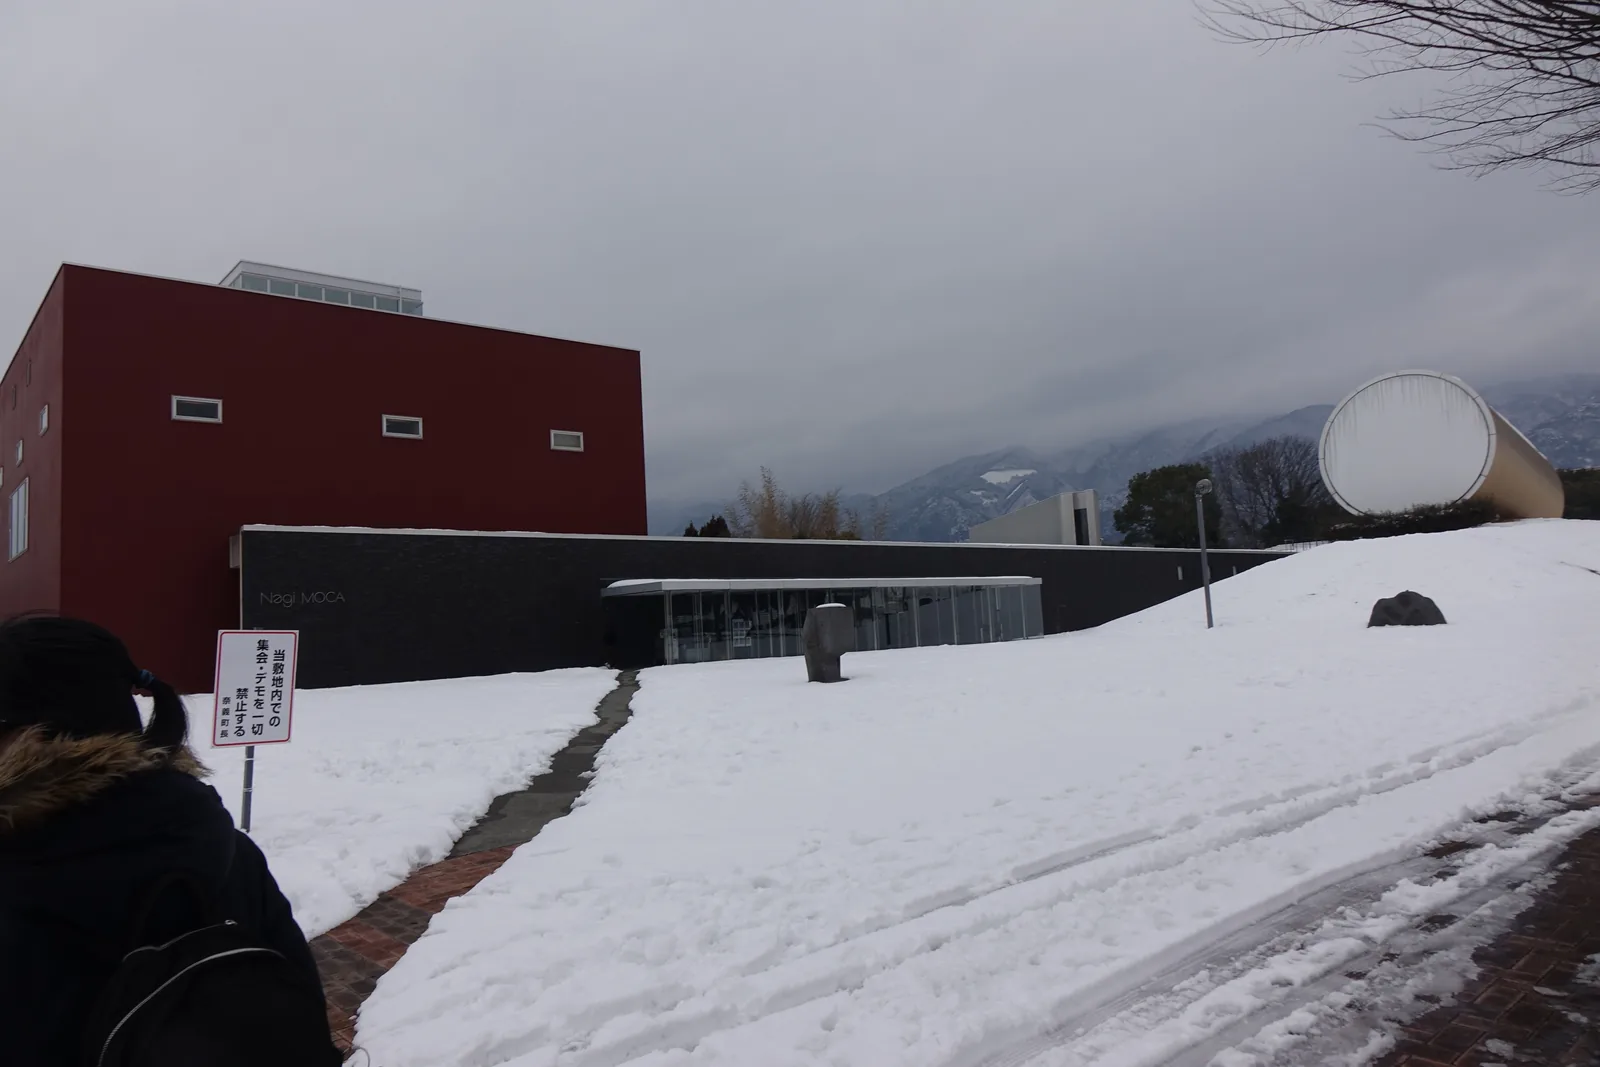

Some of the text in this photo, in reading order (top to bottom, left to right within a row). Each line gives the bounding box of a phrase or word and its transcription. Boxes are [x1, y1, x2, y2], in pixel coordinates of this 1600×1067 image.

[260, 591, 346, 608] Nagi MOCA
[233, 687, 249, 737] 禁止する
[251, 639, 269, 736] 集会・デモを一切
[268, 649, 286, 727] 当敷地内での
[219, 696, 231, 738] 奈義町長
